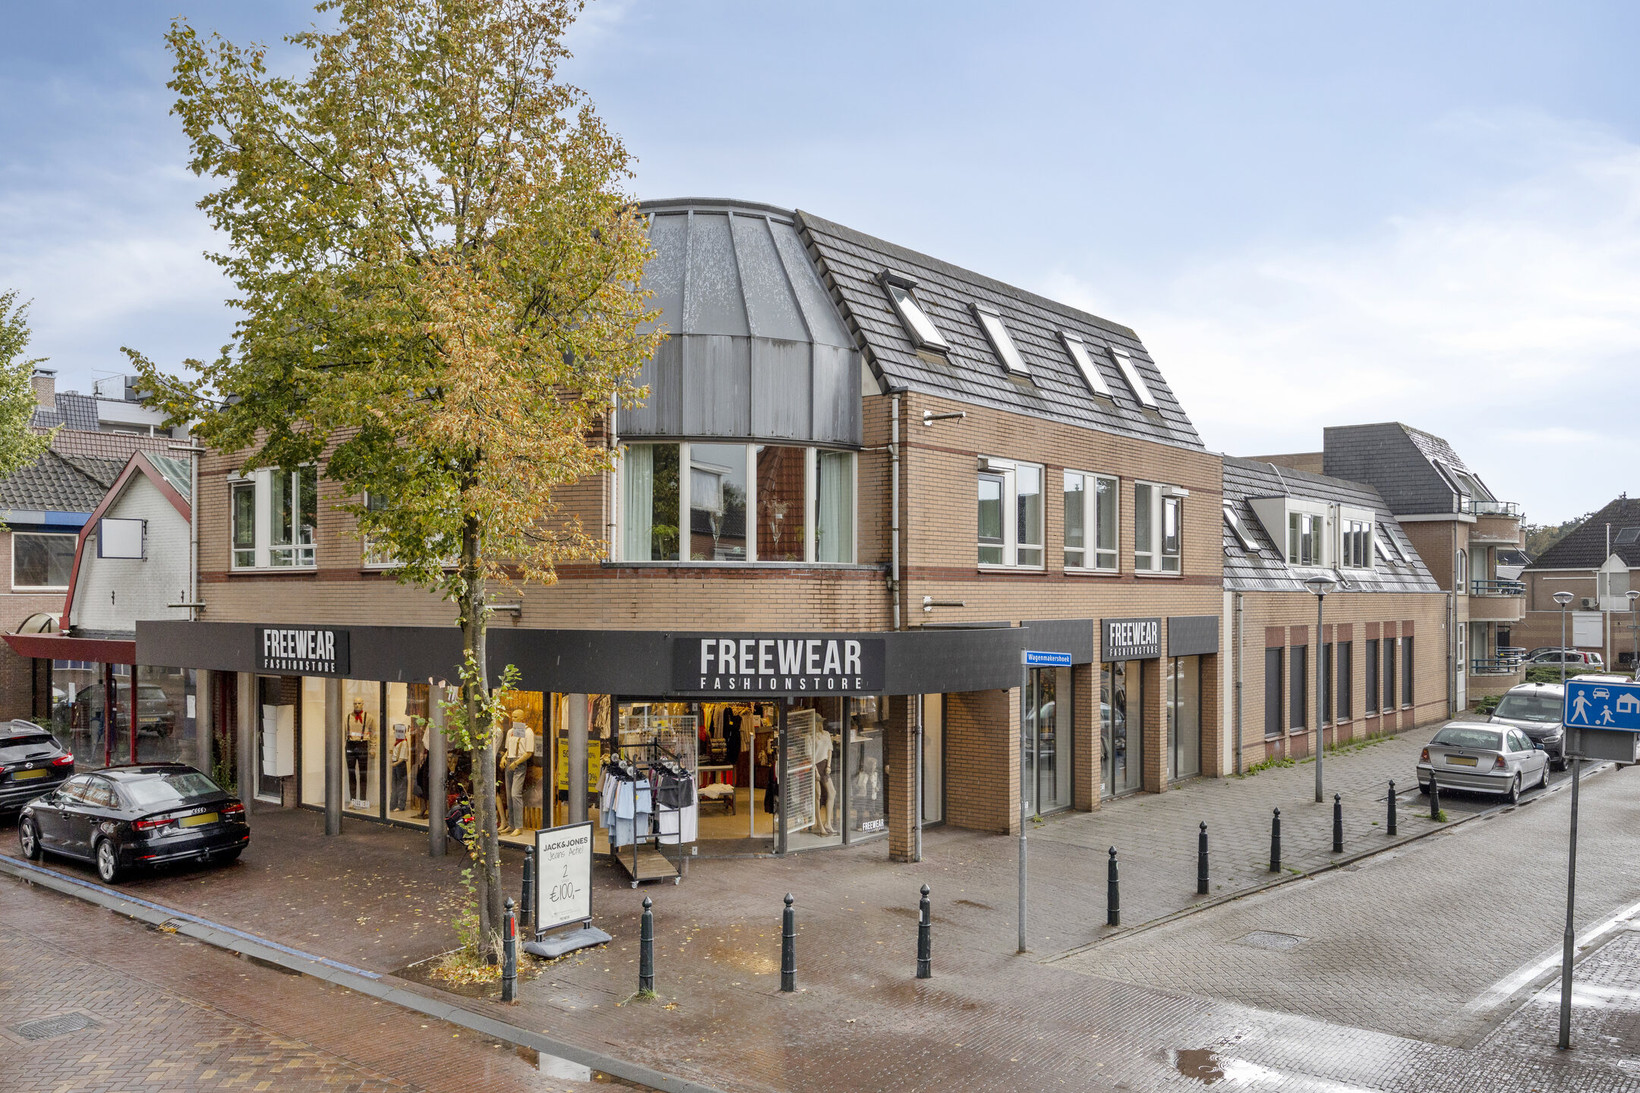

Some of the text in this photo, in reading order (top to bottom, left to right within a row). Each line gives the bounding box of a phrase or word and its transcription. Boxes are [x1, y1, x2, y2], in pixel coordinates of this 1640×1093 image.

[1109, 621, 1158, 647] FREEWEAR
[263, 629, 335, 660] FREEWEAR
[1109, 645, 1158, 657] FASHIONSTORE
[700, 638, 862, 675] FREEWEAR
[264, 658, 335, 673] FASHIONSTORE
[700, 677, 862, 690] FASHIONSTORE
[862, 818, 885, 831] FREEWEAR
[543, 836, 589, 852] JACK&JONES
[562, 864, 569, 878] 2
